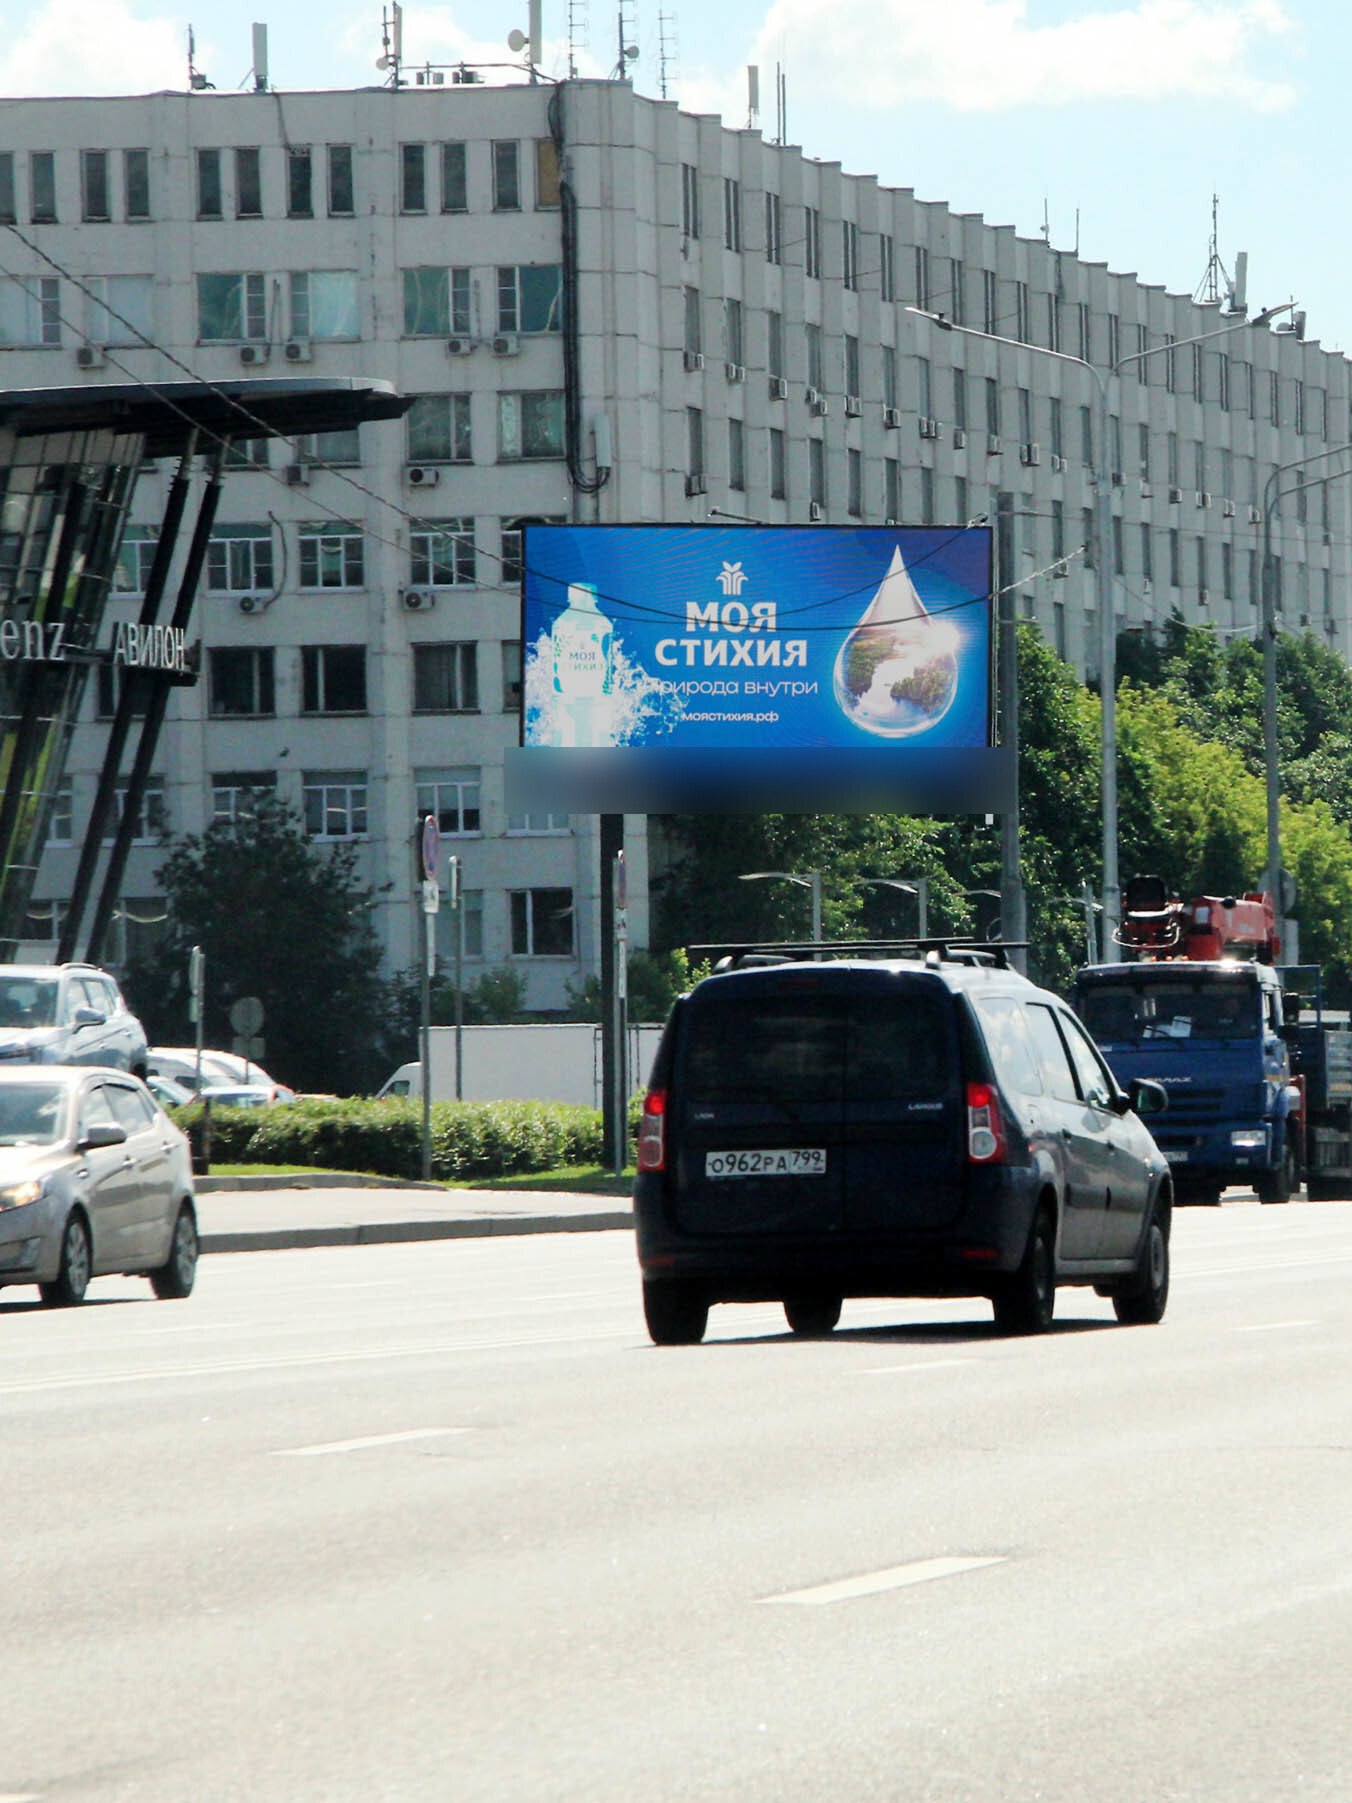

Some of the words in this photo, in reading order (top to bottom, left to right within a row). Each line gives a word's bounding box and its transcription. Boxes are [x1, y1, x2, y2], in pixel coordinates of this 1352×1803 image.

[686, 601, 777, 633] МОЯ
[114, 622, 185, 670] АВИЛОН
[655, 638, 808, 667] СТИХИЯ
[744, 681, 819, 698] внутри
[681, 710, 779, 723] моястихия.рф
[791, 1151, 821, 1166] 799
